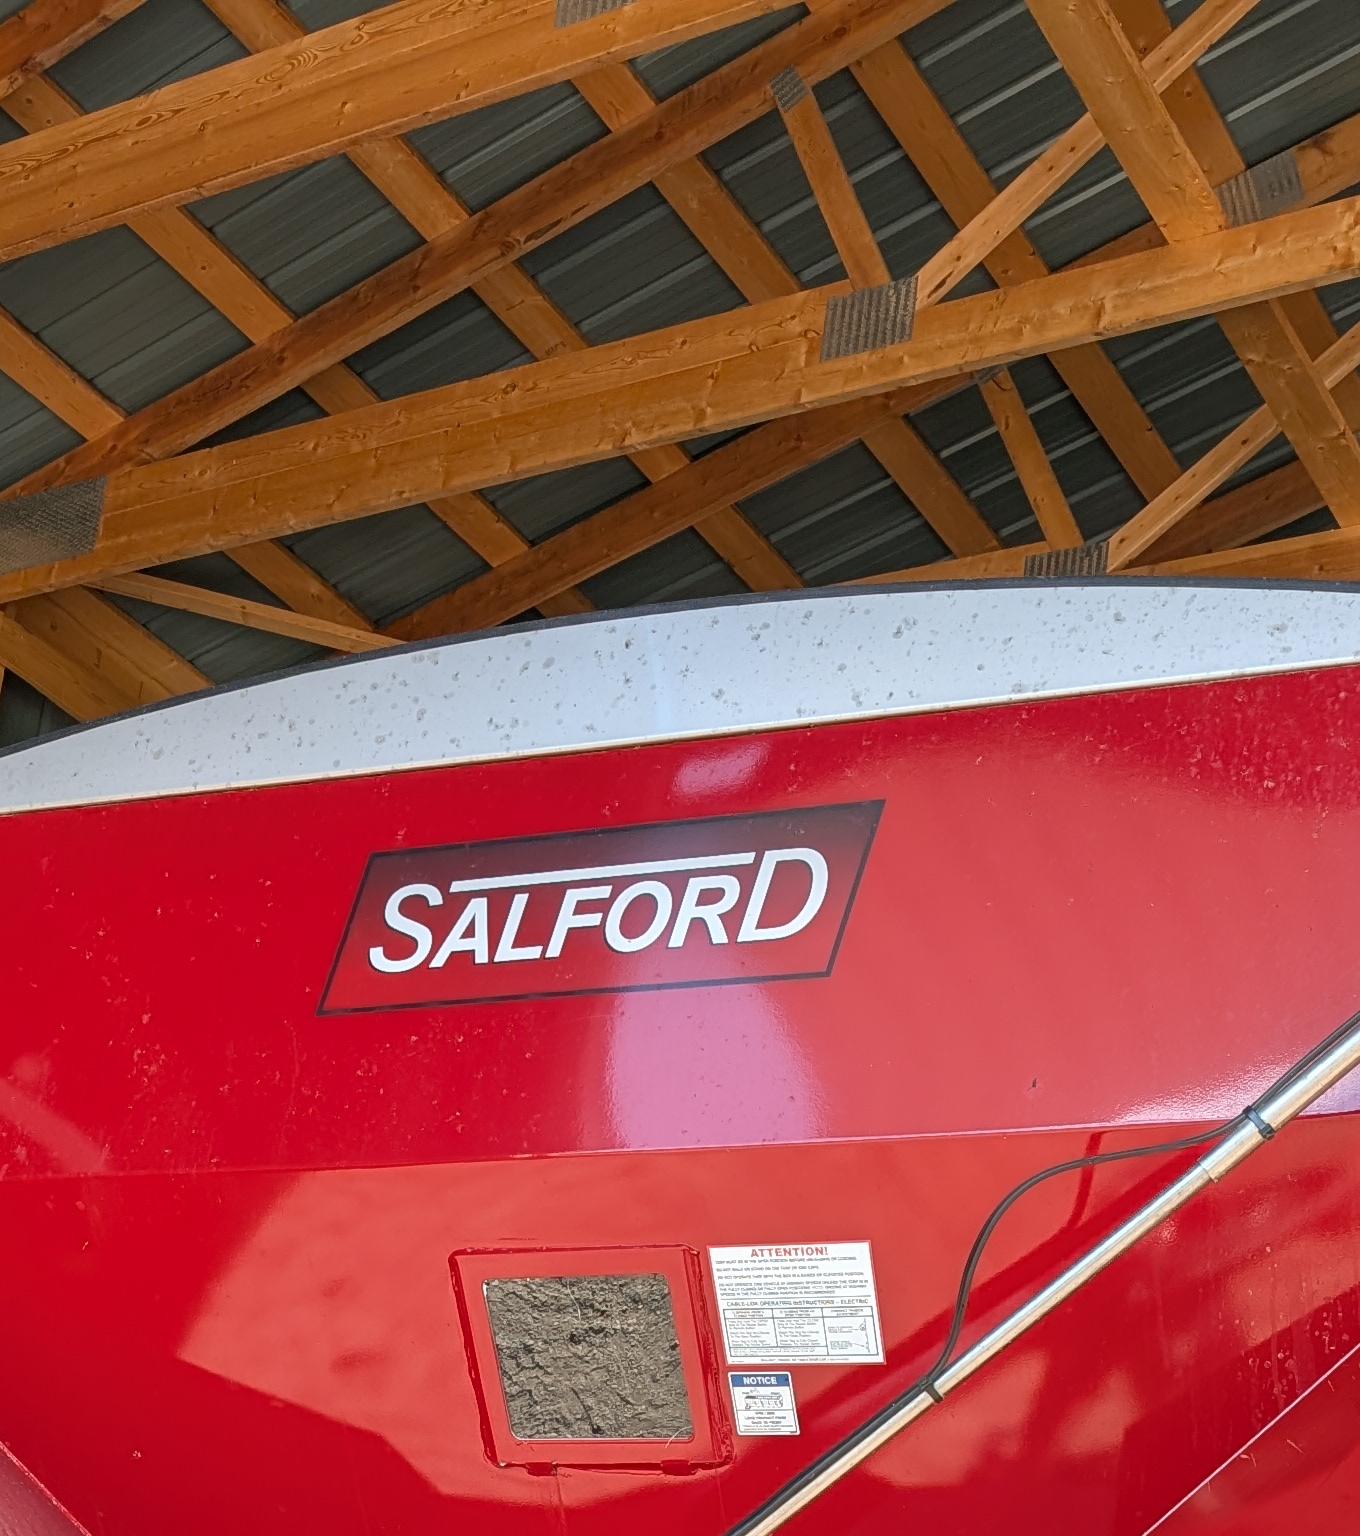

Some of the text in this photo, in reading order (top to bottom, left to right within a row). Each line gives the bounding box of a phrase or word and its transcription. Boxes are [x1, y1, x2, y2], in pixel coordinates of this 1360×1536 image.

[368, 846, 830, 975] SALFORD
[750, 1246, 828, 1258] ATTENTION!
[742, 1376, 778, 1387] NOTICE
